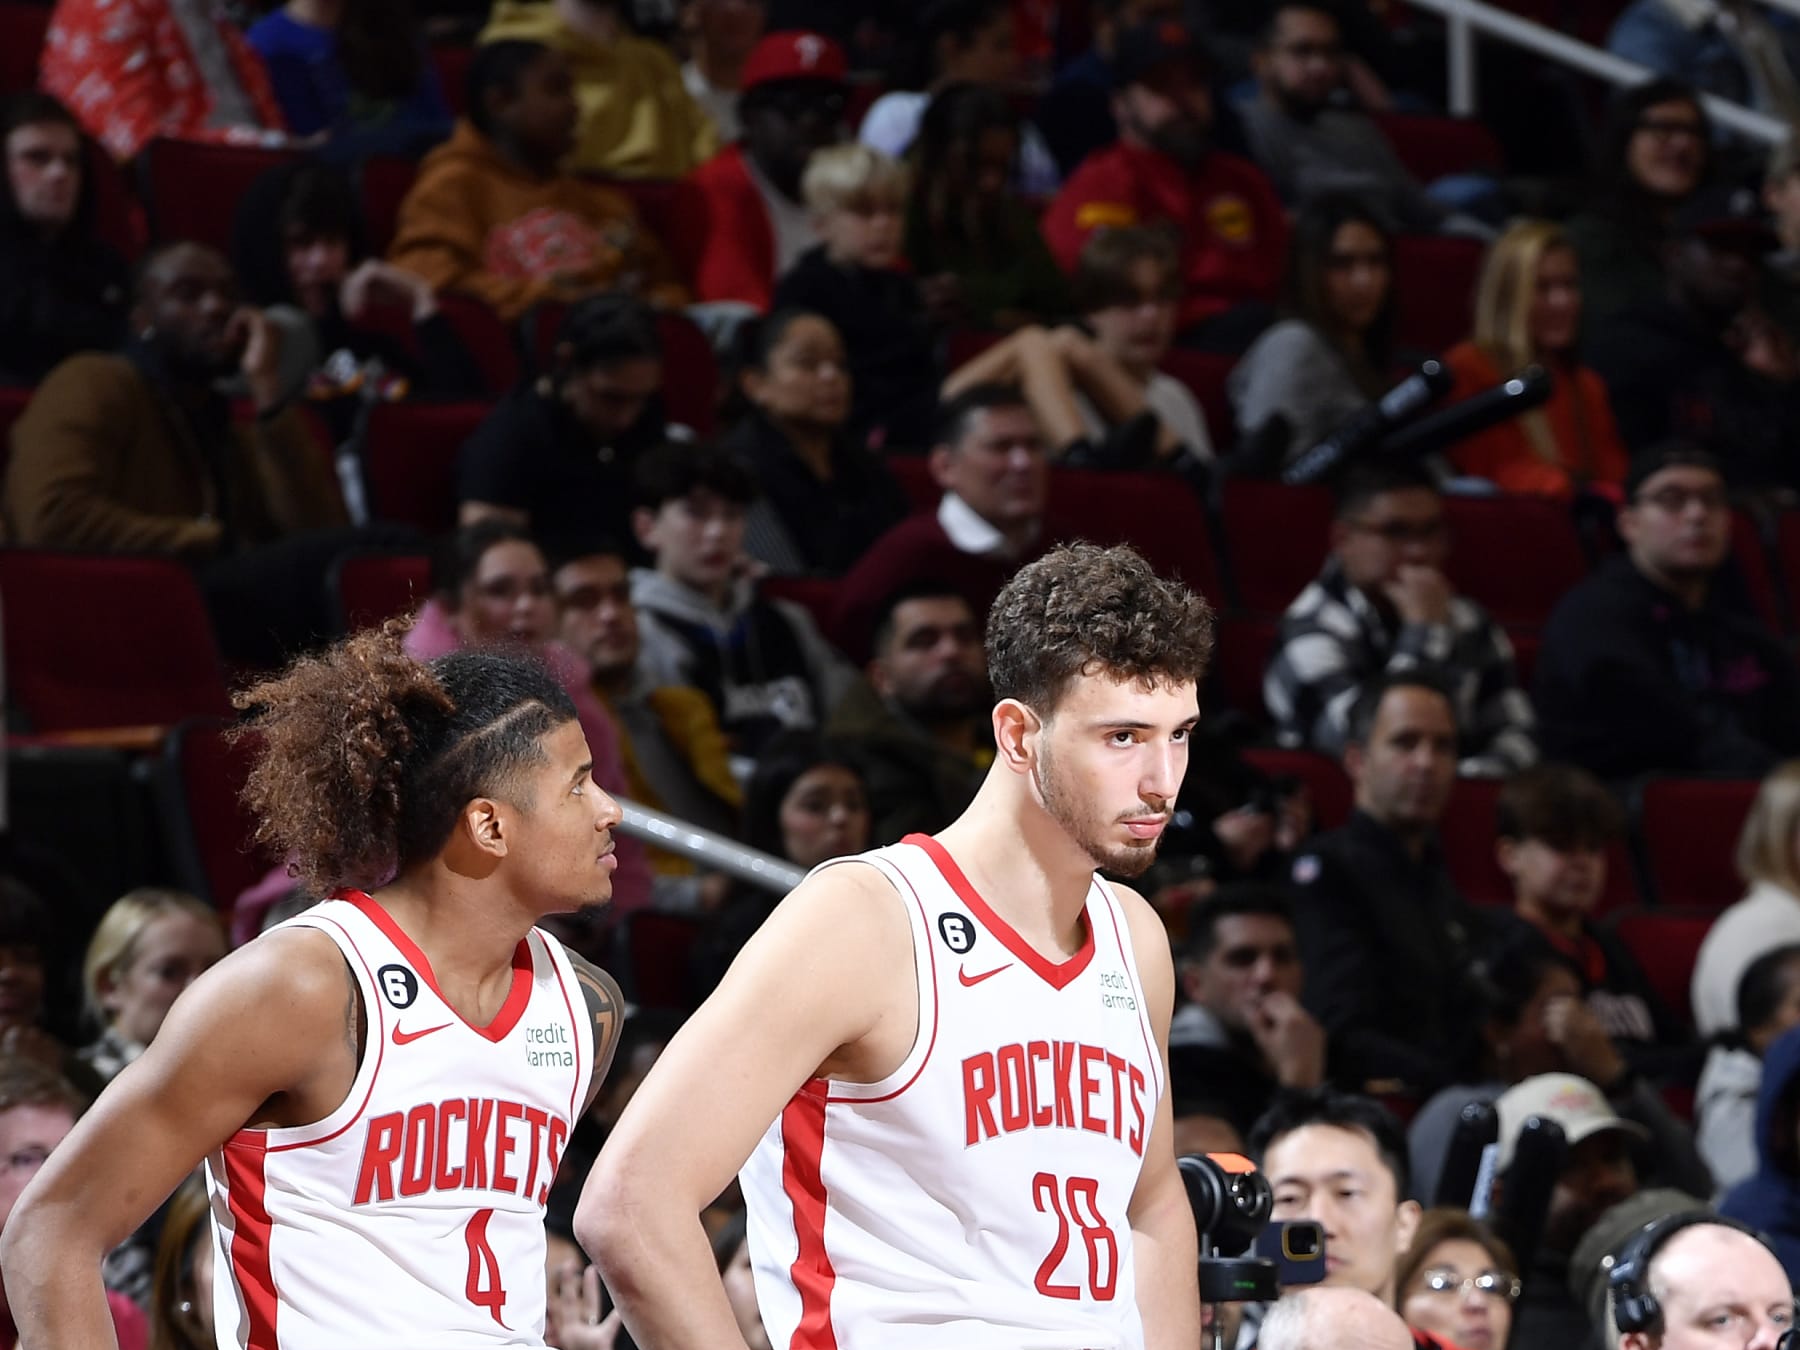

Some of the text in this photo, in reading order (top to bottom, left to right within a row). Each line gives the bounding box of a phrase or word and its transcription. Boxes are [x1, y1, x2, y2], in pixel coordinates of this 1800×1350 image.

[381, 968, 408, 999] 6
[943, 917, 968, 950] 6
[1102, 992, 1136, 1011] arma
[351, 1097, 568, 1209] ROCKETS
[961, 1039, 1146, 1158] ROCKETS
[464, 1208, 515, 1332] 4
[1031, 1171, 1119, 1301] 28
